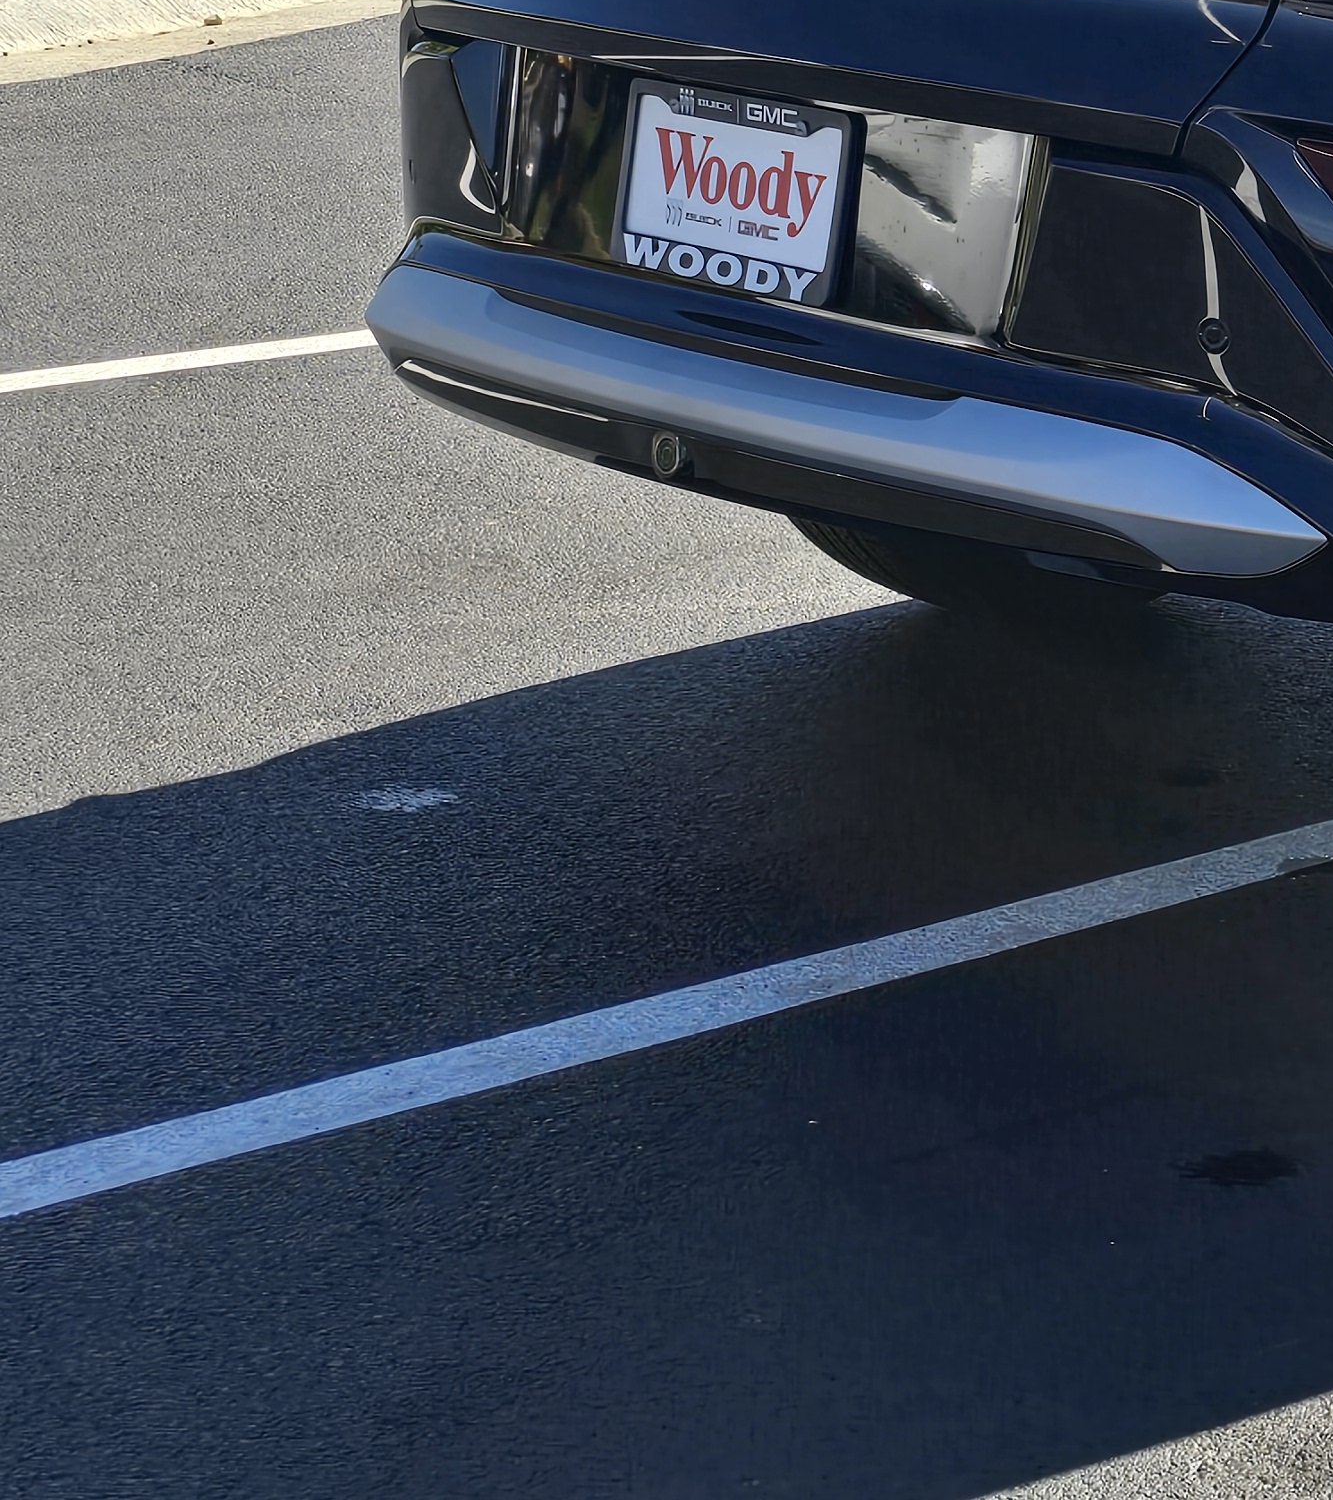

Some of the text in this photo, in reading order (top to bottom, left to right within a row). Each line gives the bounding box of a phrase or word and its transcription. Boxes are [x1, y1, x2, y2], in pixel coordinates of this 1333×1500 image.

[746, 103, 799, 128] GMC
[655, 127, 828, 238] Woody
[737, 219, 781, 242] GMC
[623, 233, 818, 302] WOODY
